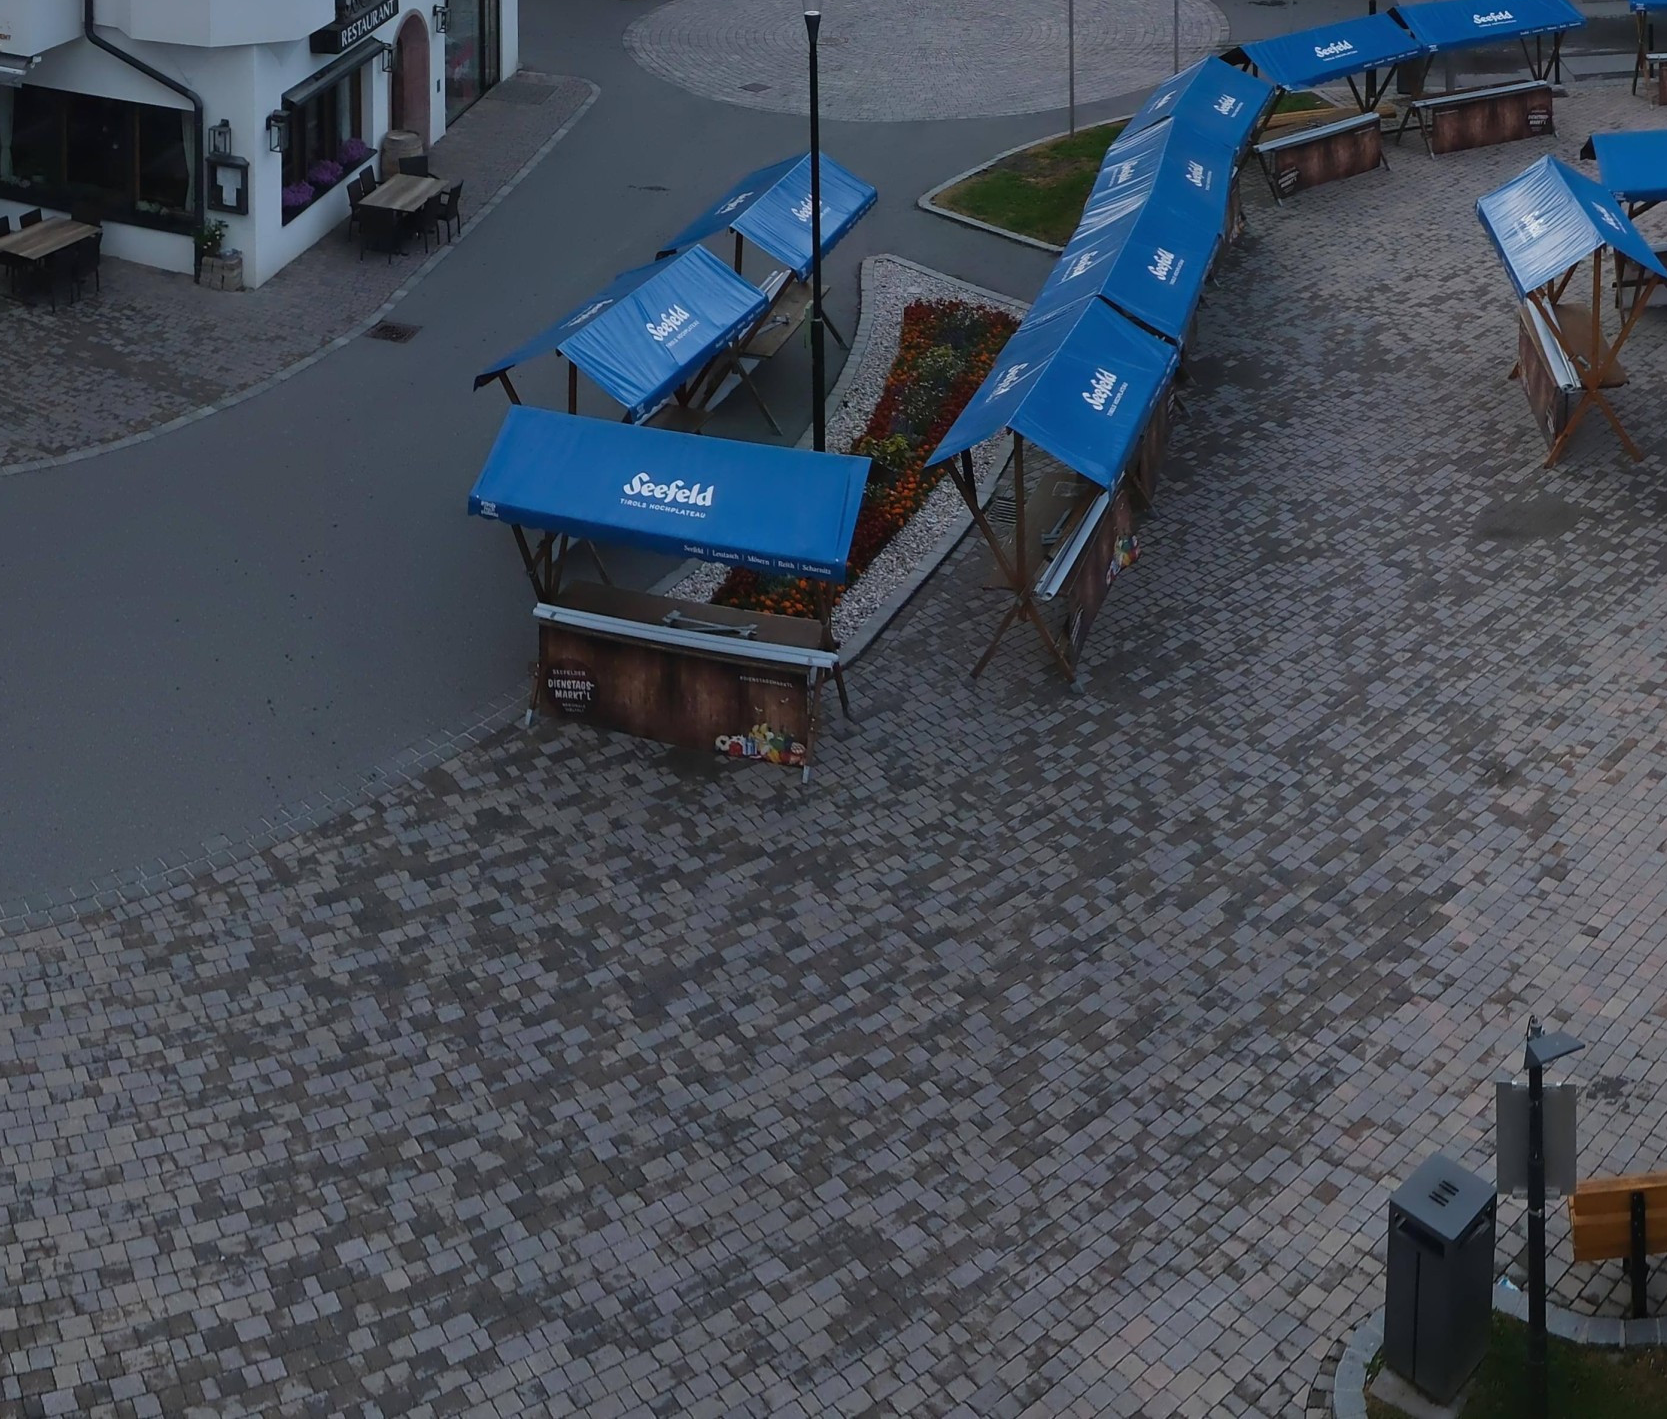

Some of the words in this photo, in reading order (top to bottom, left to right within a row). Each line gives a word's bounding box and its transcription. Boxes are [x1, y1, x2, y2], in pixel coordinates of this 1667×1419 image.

[1472, 9, 1514, 25] Seefeld
[1314, 39, 1354, 59] Seefeld
[791, 193, 822, 223] Seefe
[1147, 246, 1176, 282] Seefeld
[646, 303, 690, 343] Seefeld
[1082, 367, 1118, 412] Seefeld
[623, 471, 715, 508] Seefeld
[620, 497, 647, 510] TIROLS
[649, 503, 707, 519] HOCHPLATEAU
[547, 677, 595, 692] DIENSTAGS-
